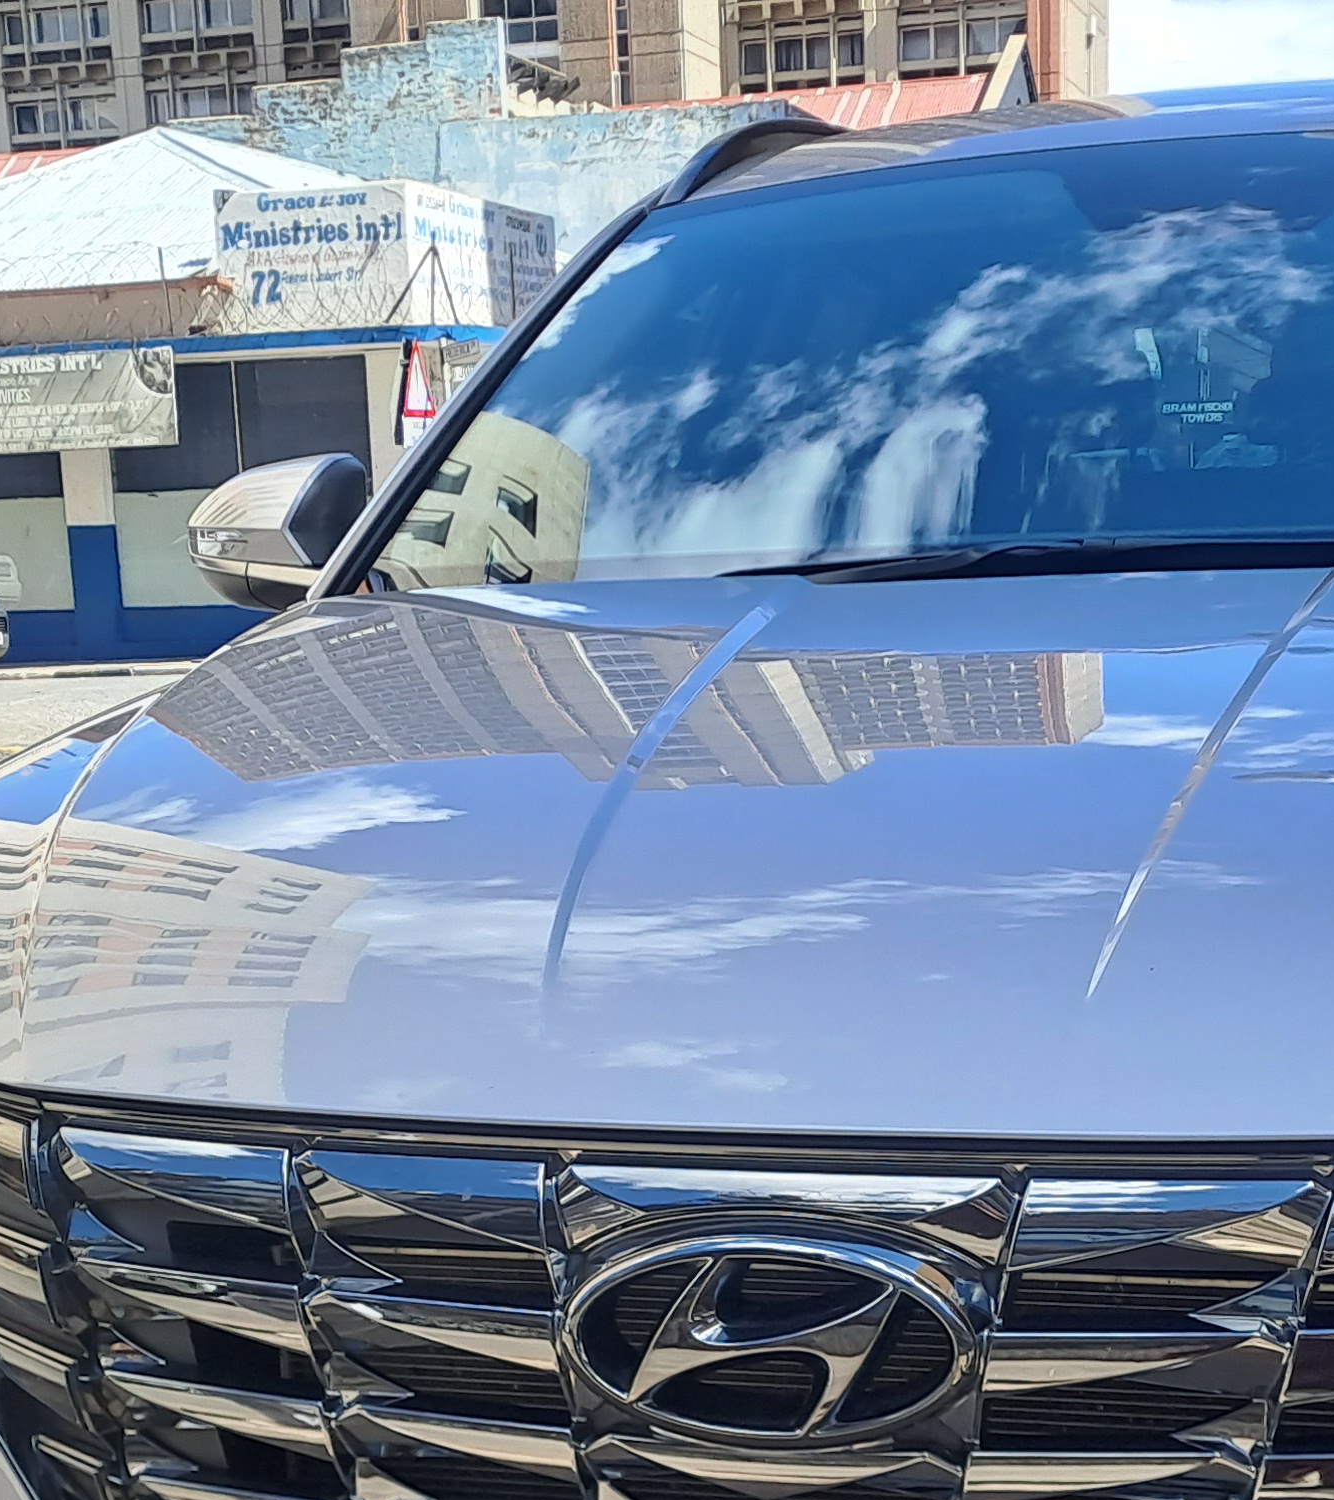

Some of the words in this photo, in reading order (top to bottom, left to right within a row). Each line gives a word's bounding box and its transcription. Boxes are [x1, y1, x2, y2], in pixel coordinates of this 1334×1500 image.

[257, 192, 315, 212] Grace
[220, 218, 349, 251] Ministries
[251, 268, 283, 307] 72
